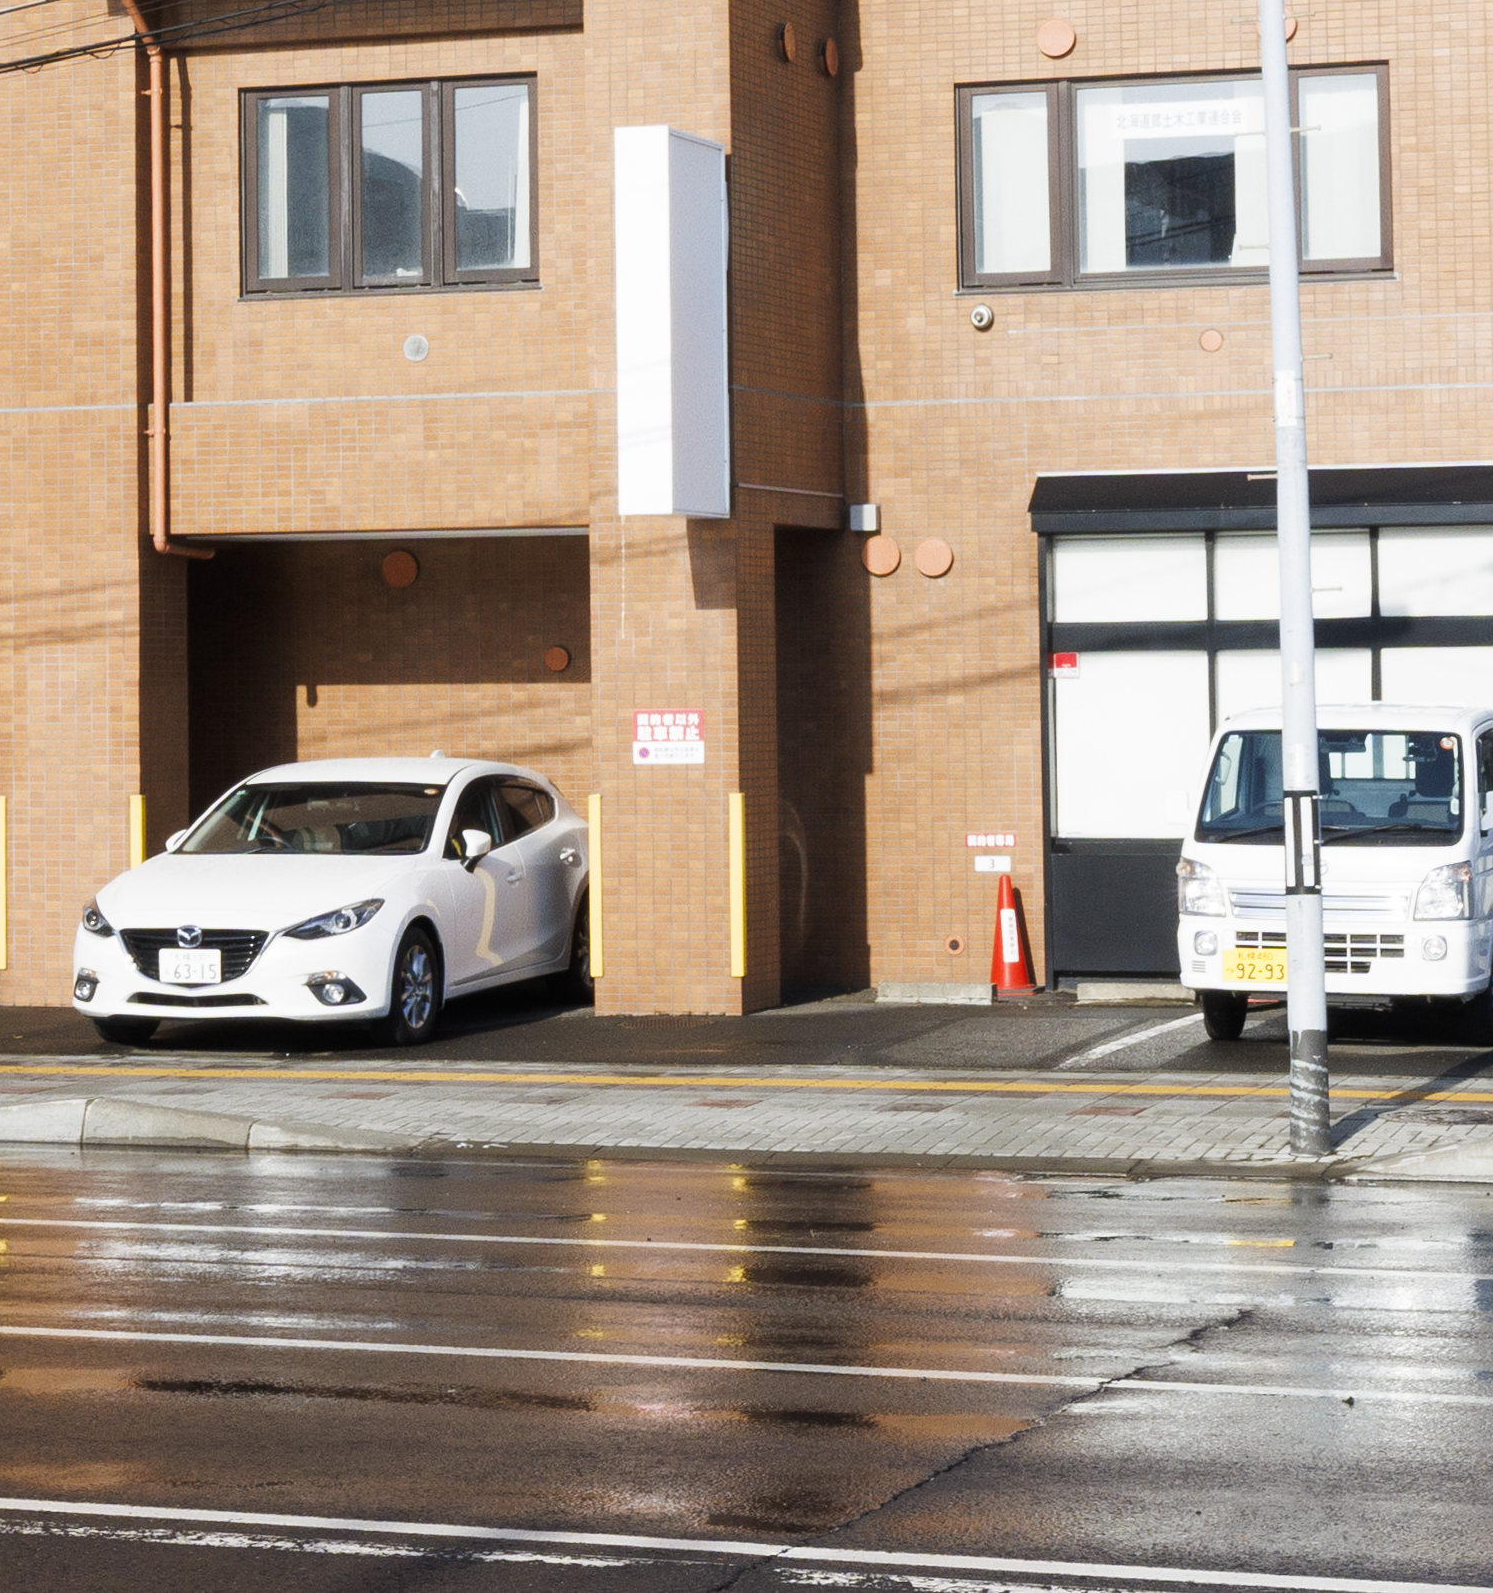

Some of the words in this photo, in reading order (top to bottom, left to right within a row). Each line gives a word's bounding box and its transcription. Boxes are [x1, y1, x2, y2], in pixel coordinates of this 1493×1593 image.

[989, 858, 995, 869] 3
[174, 964, 217, 980] 63-15
[1236, 962, 1285, 980] 92-93
